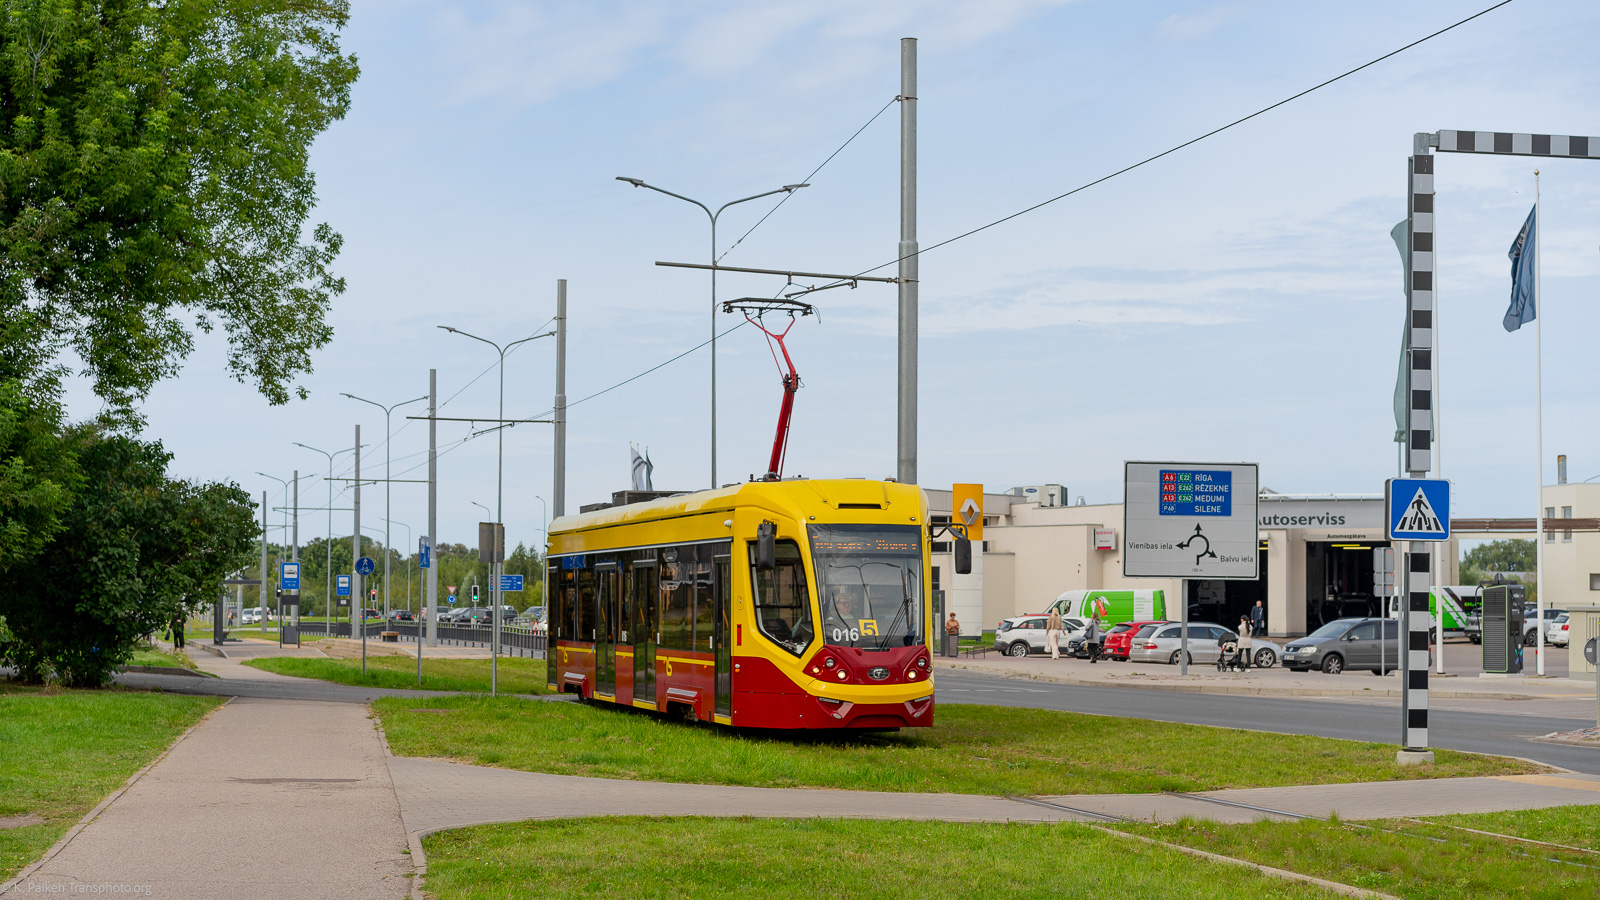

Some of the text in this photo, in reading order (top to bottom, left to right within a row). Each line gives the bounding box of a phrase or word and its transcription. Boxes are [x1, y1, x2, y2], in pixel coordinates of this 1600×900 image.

[1195, 473, 1212, 482] RĪGA
[1195, 484, 1229, 492] RĒZEKNE
[862, 622, 876, 636] 5
[832, 628, 859, 642] 016
